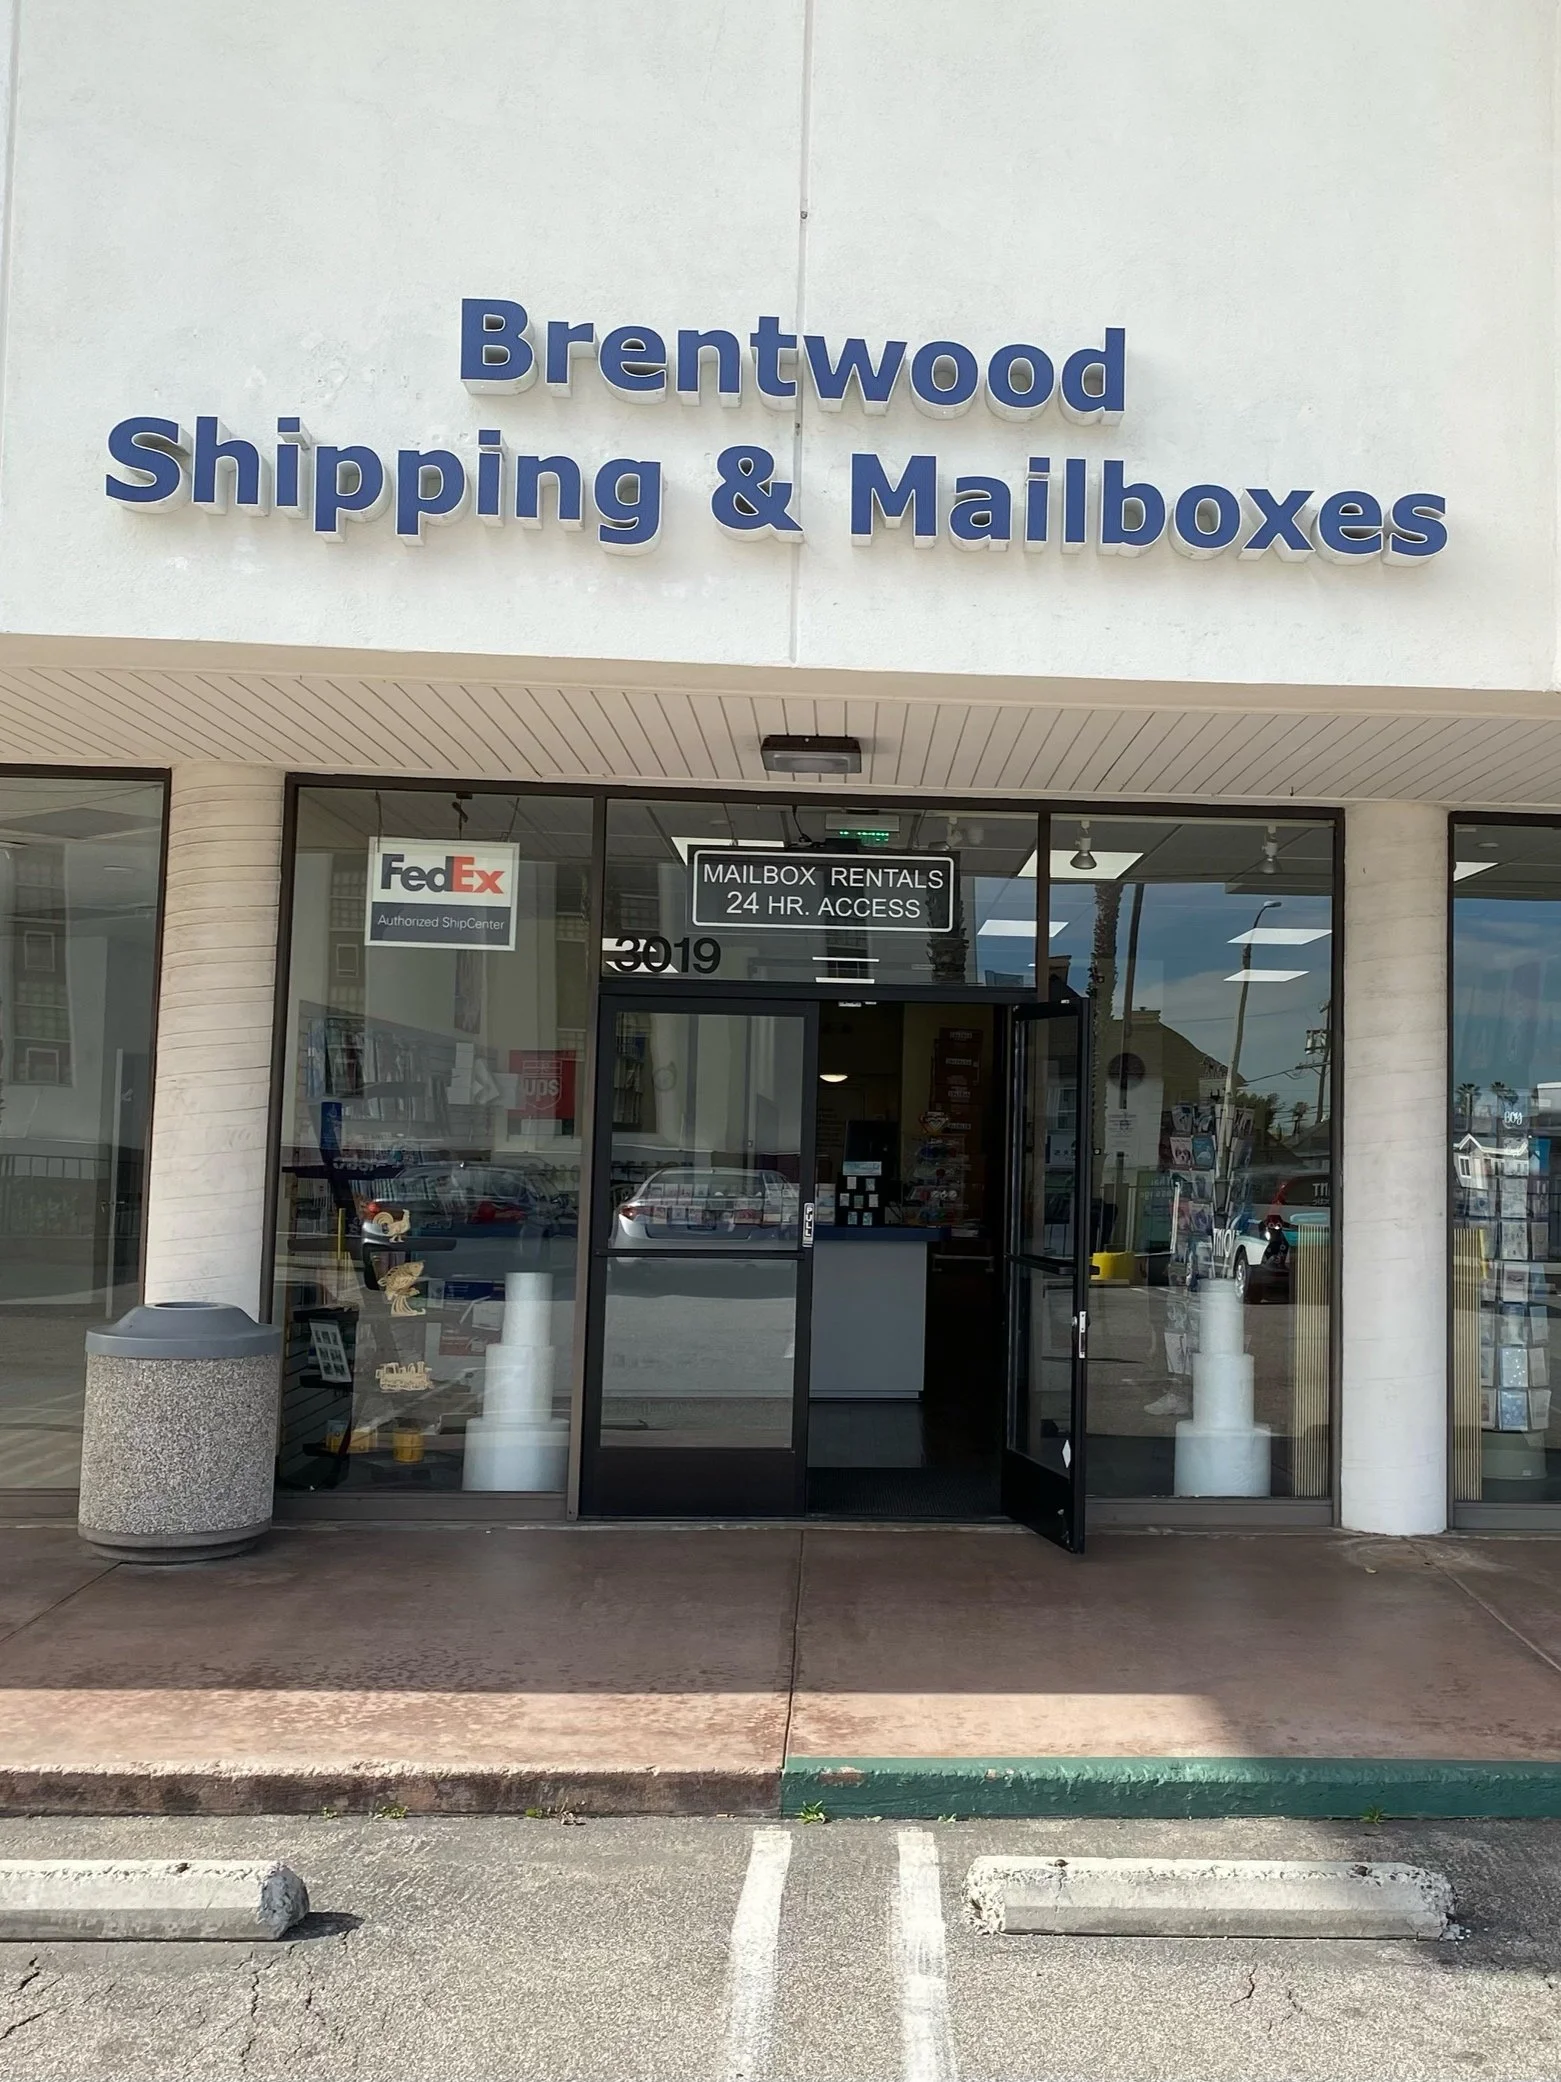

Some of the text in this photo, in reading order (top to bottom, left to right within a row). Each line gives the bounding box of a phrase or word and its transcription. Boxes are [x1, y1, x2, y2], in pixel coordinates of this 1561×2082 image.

[461, 298, 1126, 415] Brentwood
[106, 416, 1448, 556] Shipping & Mailboxes
[380, 853, 506, 895] FedEx
[702, 863, 944, 890] MAILBOX RENTALS
[726, 891, 921, 919] 24 HR. ACCESS
[377, 914, 505, 931] Authorized ShipCenter
[613, 936, 722, 974] 3019
[523, 1078, 560, 1102] ups
[804, 1207, 813, 1237] PULL
